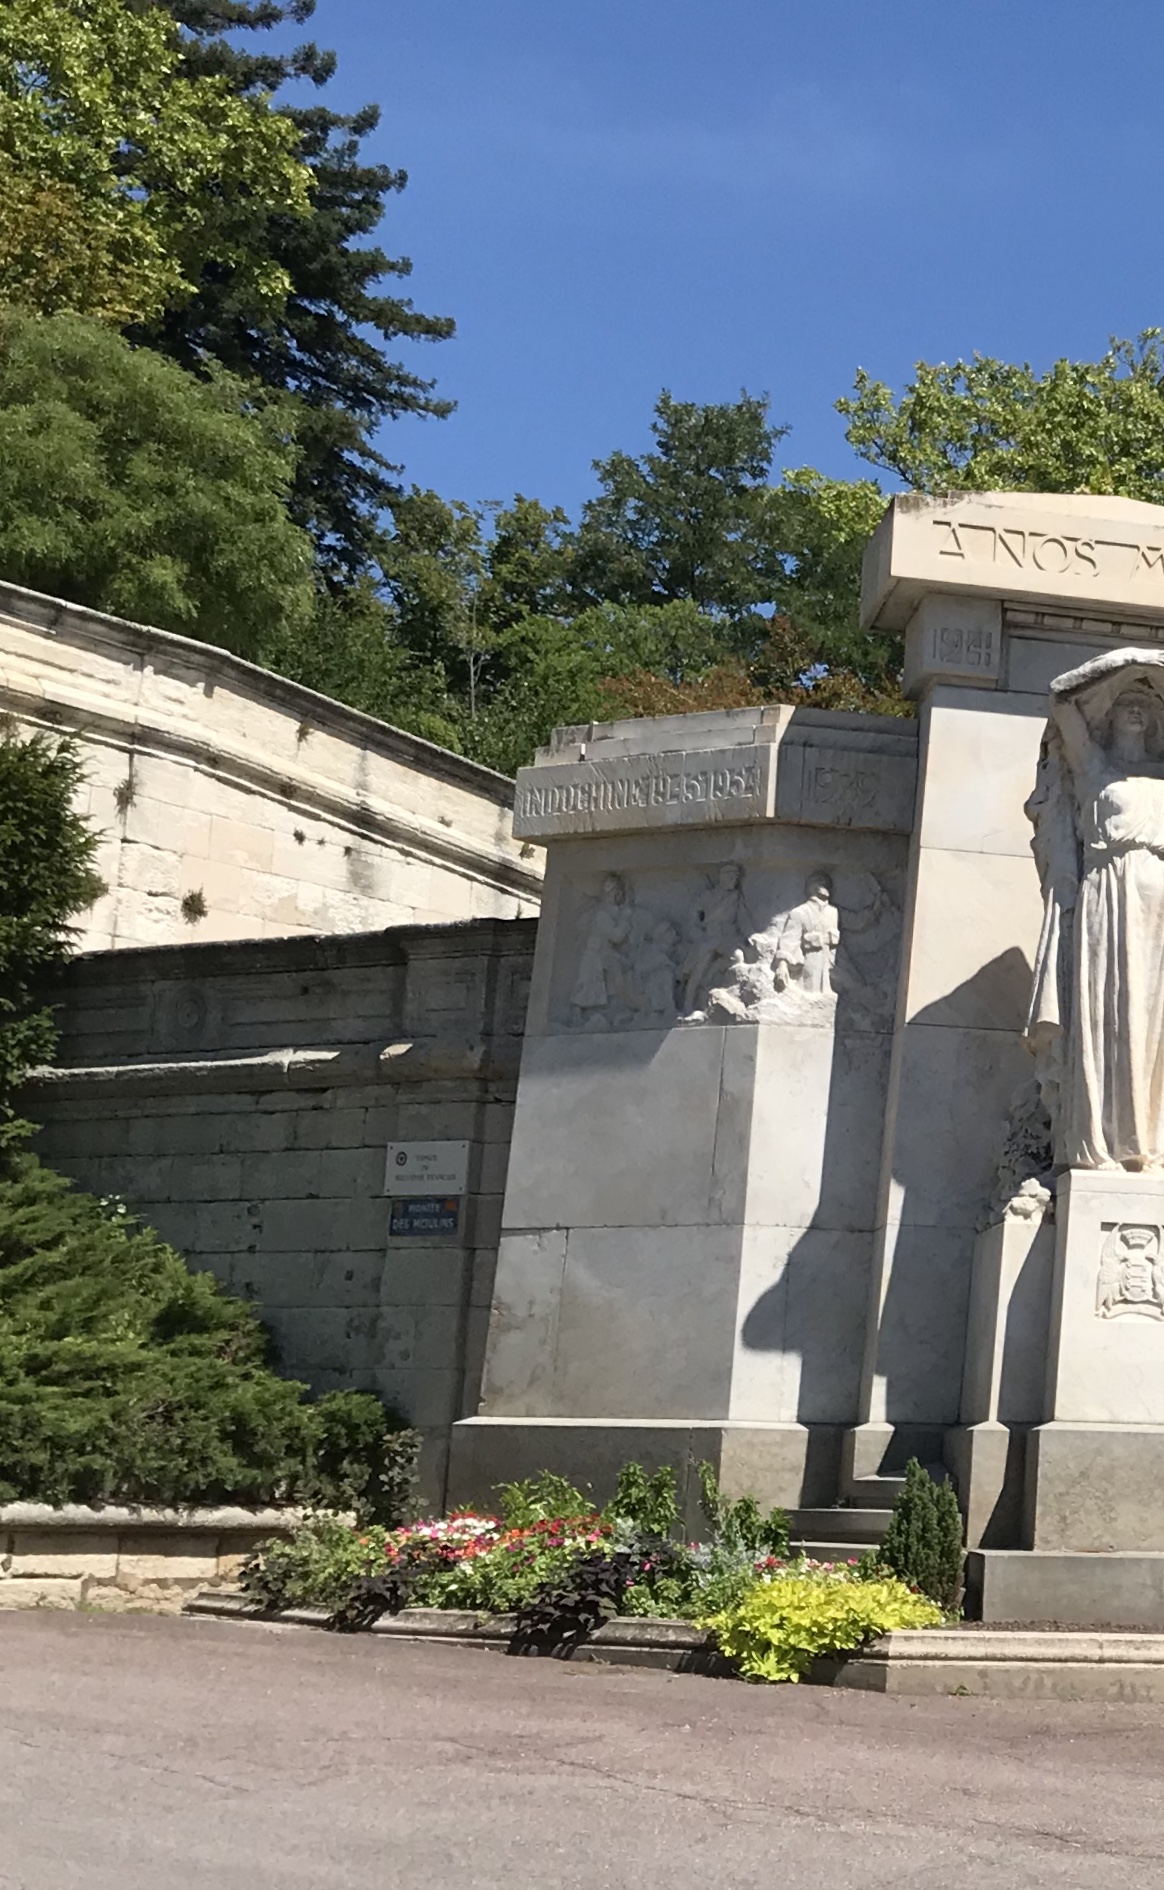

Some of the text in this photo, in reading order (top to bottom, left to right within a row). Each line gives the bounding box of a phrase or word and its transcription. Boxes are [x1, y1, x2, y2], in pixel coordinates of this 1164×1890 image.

[937, 520, 972, 563] A
[994, 526, 1101, 577] NOS
[520, 777, 648, 818] INDOCHINE
